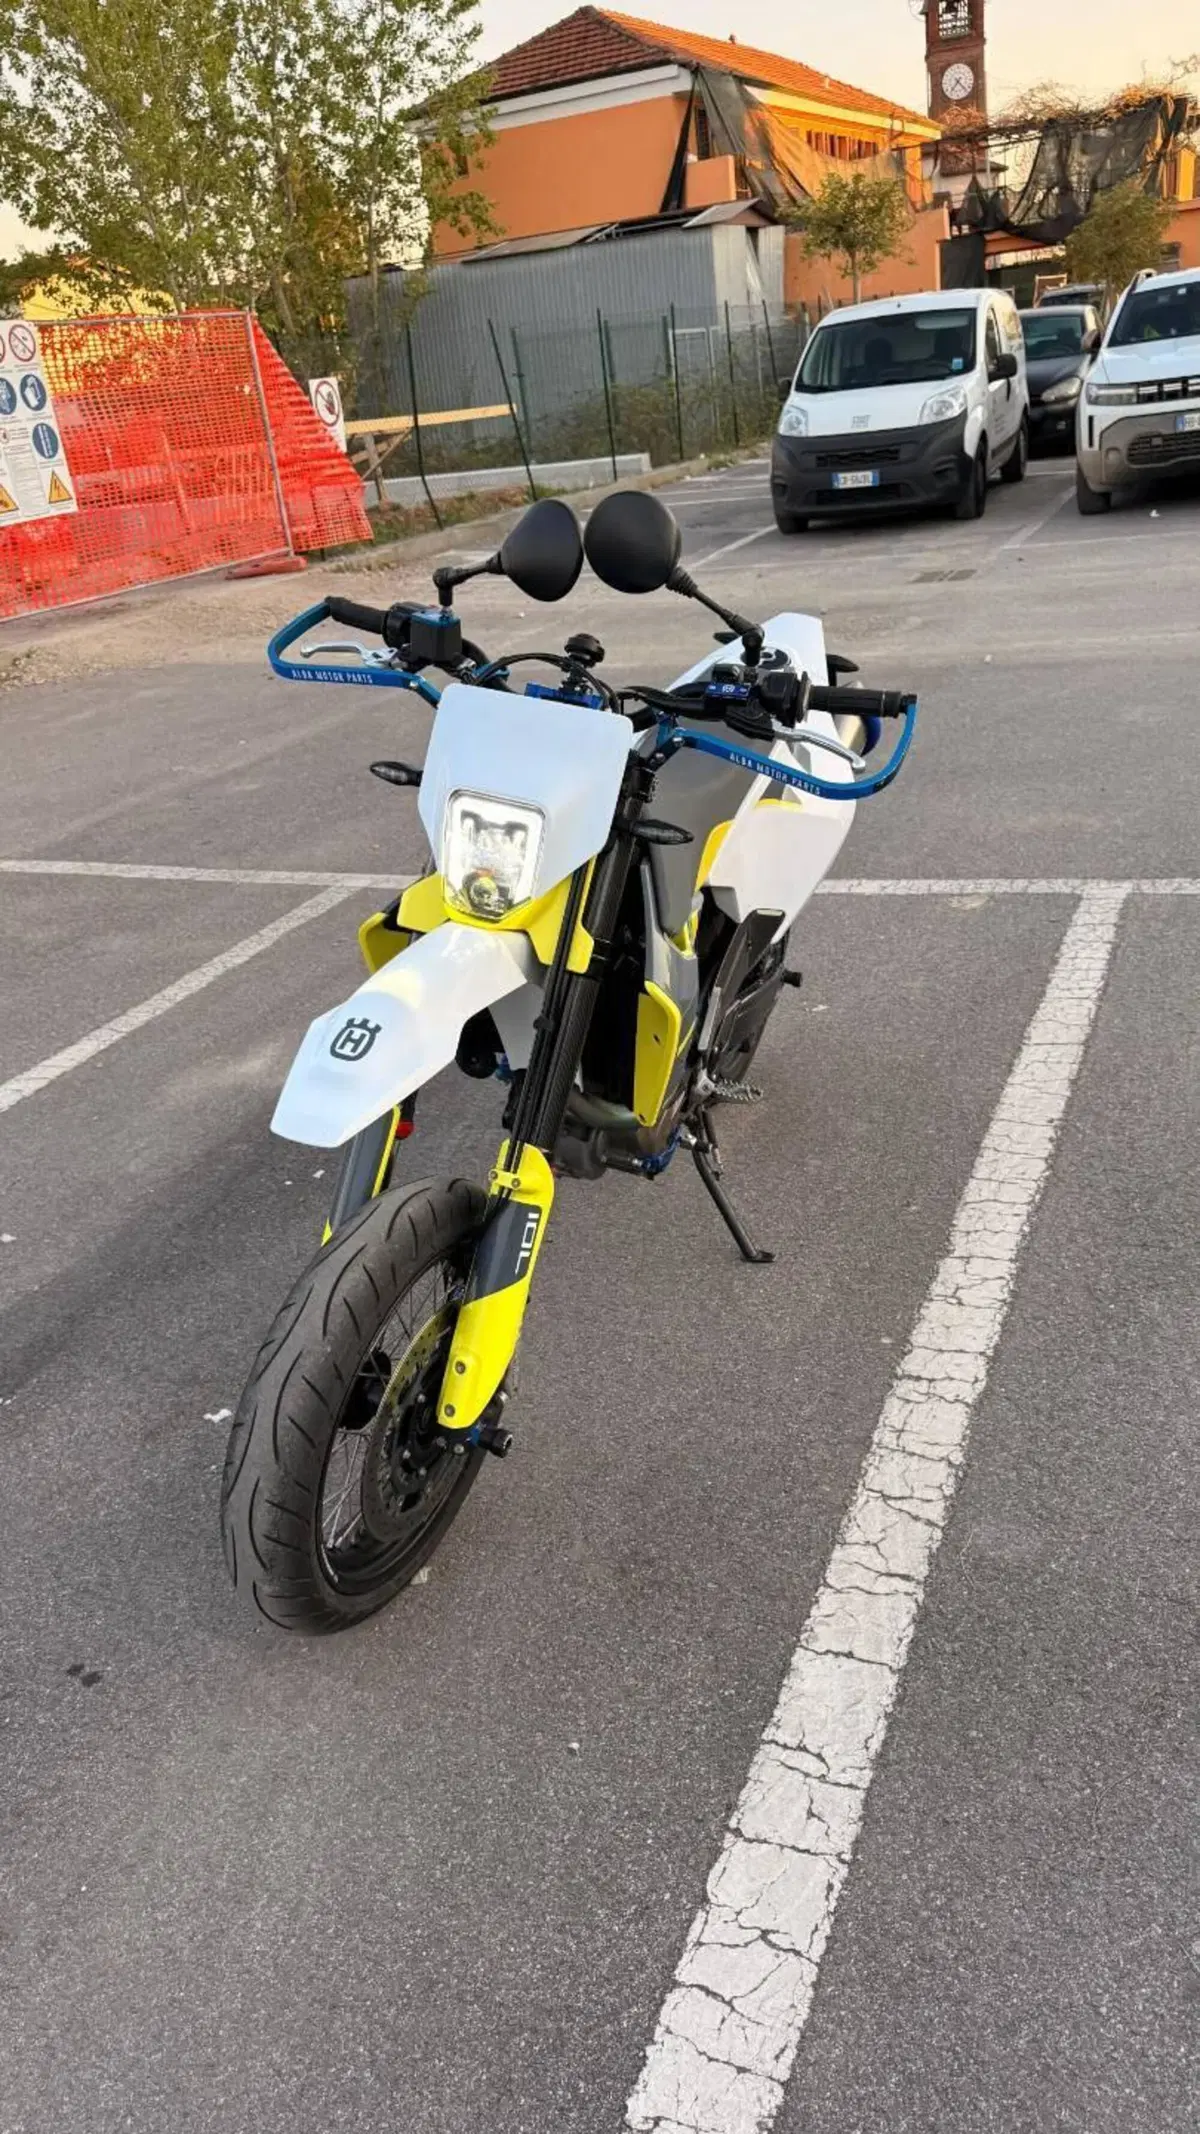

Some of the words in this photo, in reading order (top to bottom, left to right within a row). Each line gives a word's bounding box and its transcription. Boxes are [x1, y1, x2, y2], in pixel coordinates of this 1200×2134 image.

[291, 669, 314, 680] ALBA
[315, 670, 345, 683] MOTOR
[346, 672, 373, 684] PARTS
[729, 752, 753, 769] ALBA
[756, 762, 788, 783] MOTOR
[791, 777, 820, 796] PARTS
[514, 1212, 540, 1275] 701
